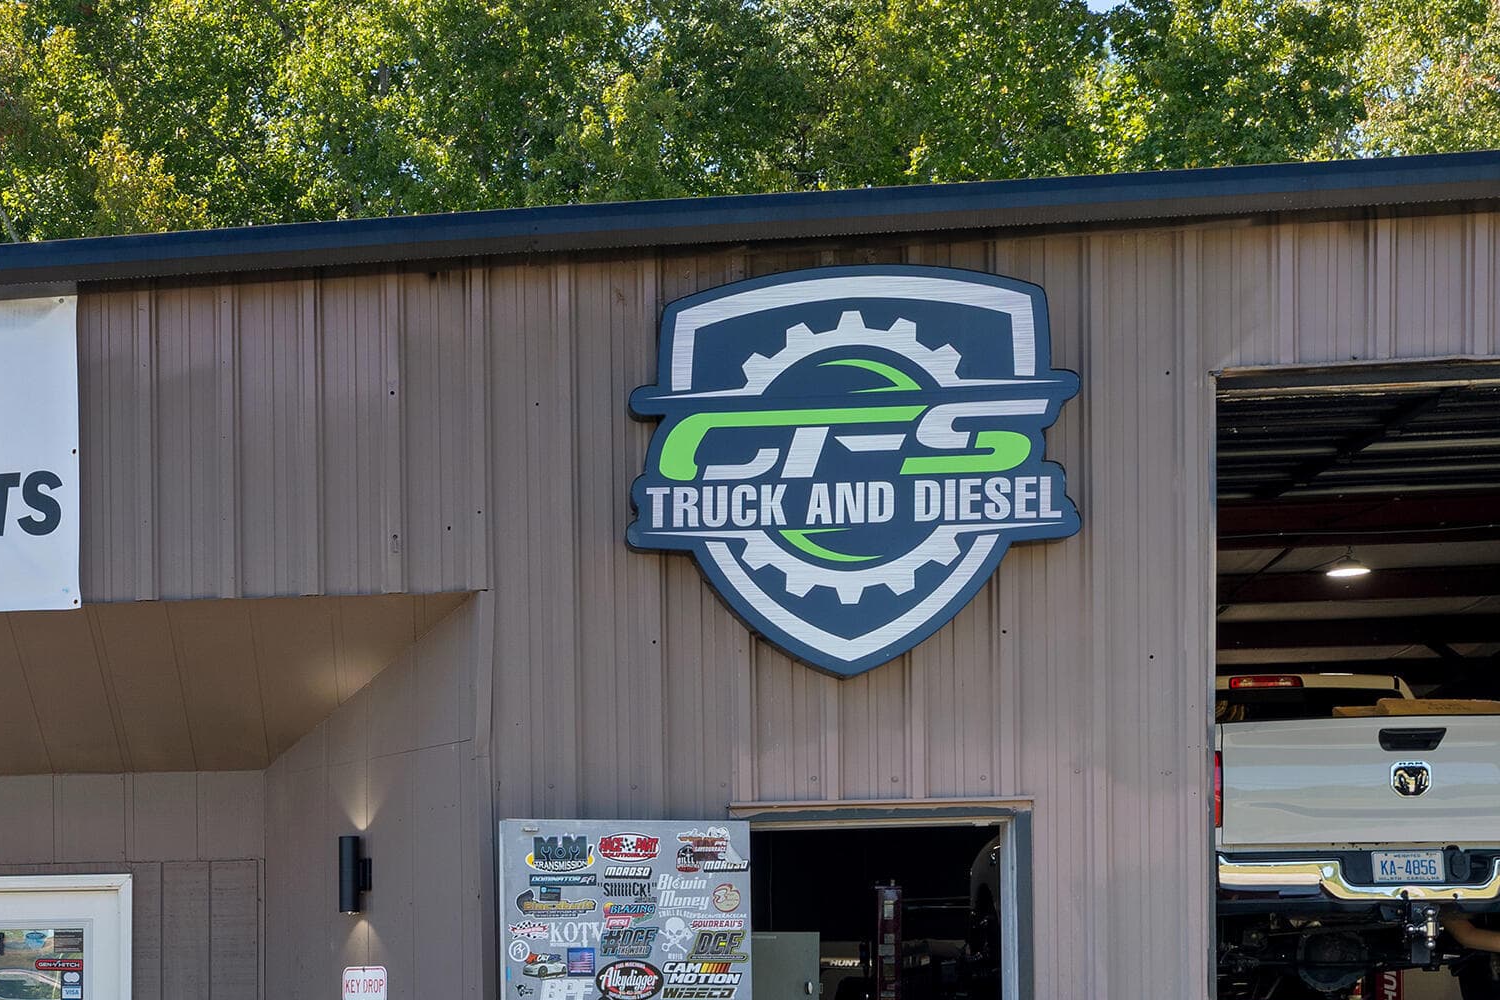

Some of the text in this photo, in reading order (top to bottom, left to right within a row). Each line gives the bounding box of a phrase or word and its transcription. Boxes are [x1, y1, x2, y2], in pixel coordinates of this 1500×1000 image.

[645, 475, 1063, 529] TRUCK AND DIESEL
[531, 860, 588, 872] TRANSMISSION
[604, 866, 650, 876] MOROSO
[1380, 859, 1437, 875] KA-4856
[658, 890, 710, 910] Money
[610, 904, 655, 914] BLAZING
[664, 962, 702, 973] CAM
[599, 966, 659, 992] Alkydigger
[668, 973, 741, 984] MOTION
[344, 978, 384, 994] KEY DROP
